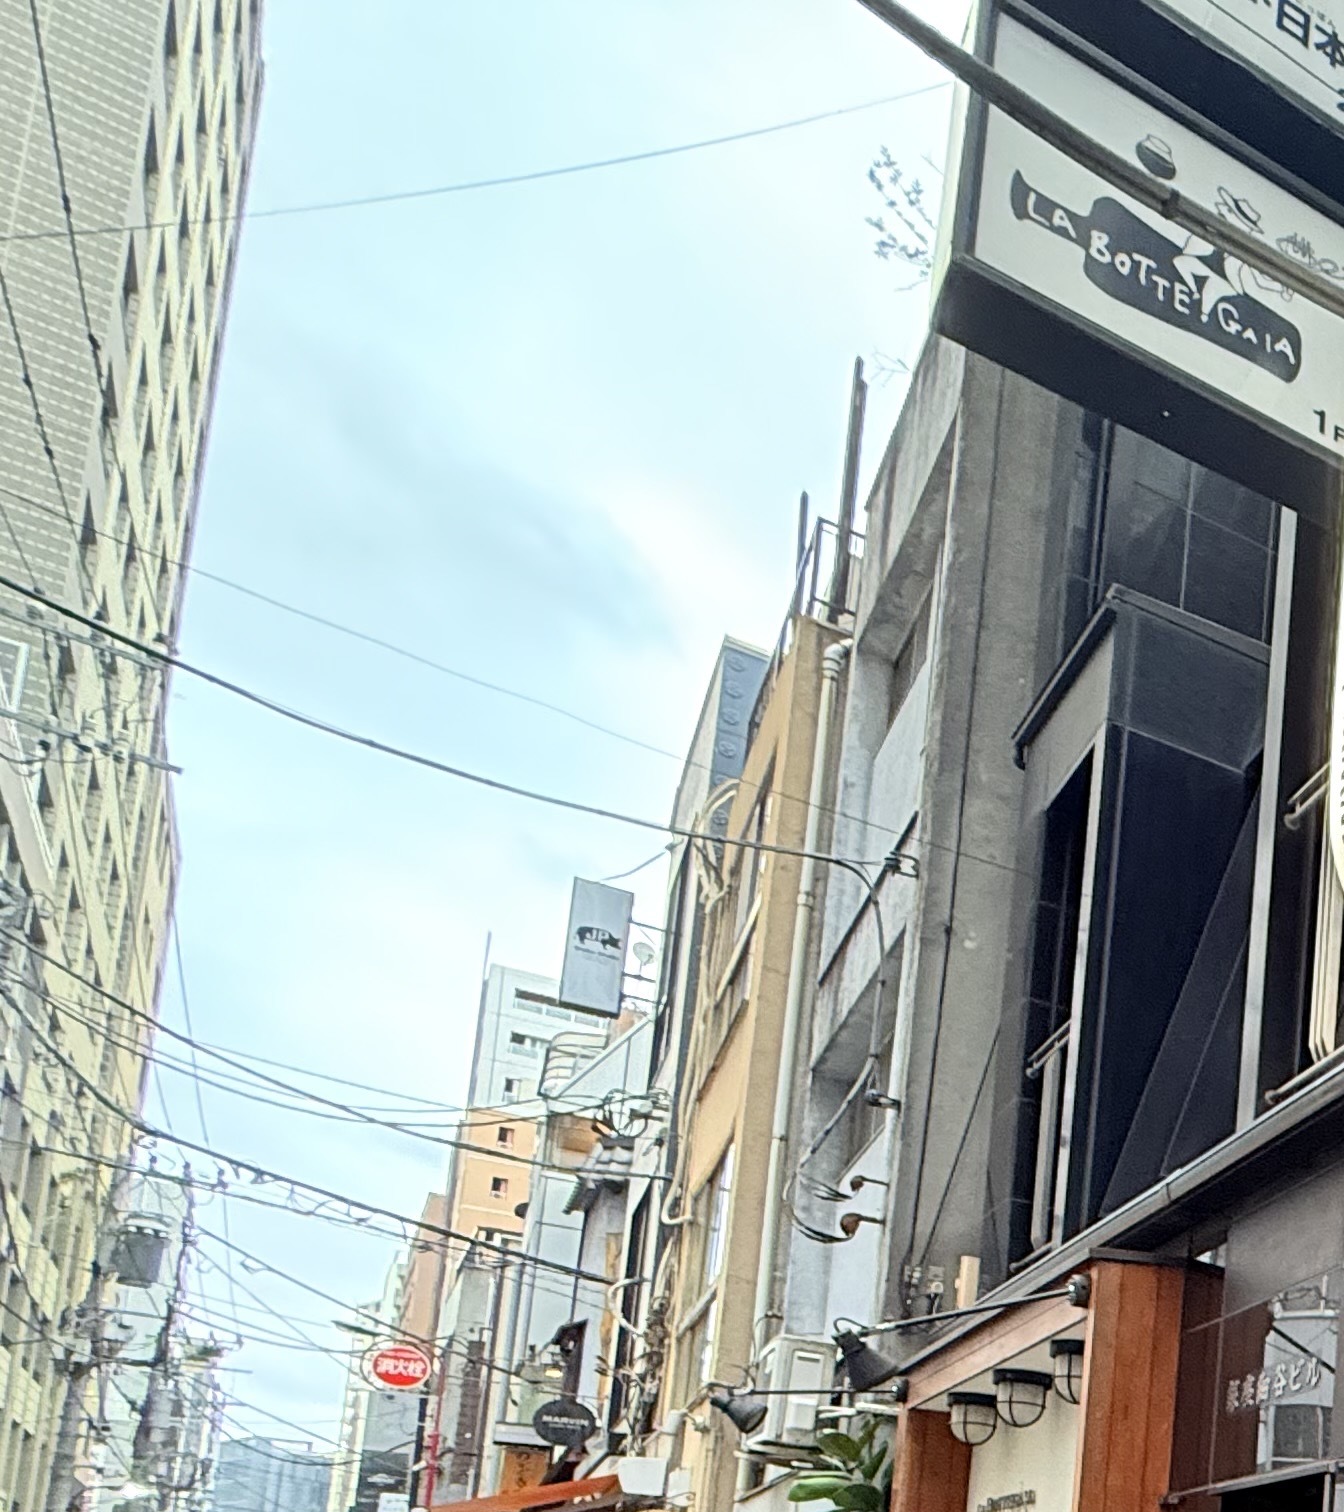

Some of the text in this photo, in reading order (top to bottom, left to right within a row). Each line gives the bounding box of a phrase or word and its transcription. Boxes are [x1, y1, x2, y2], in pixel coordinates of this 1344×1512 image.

[1026, 191, 1077, 239] LA
[376, 1357, 426, 1378] 消火栓
